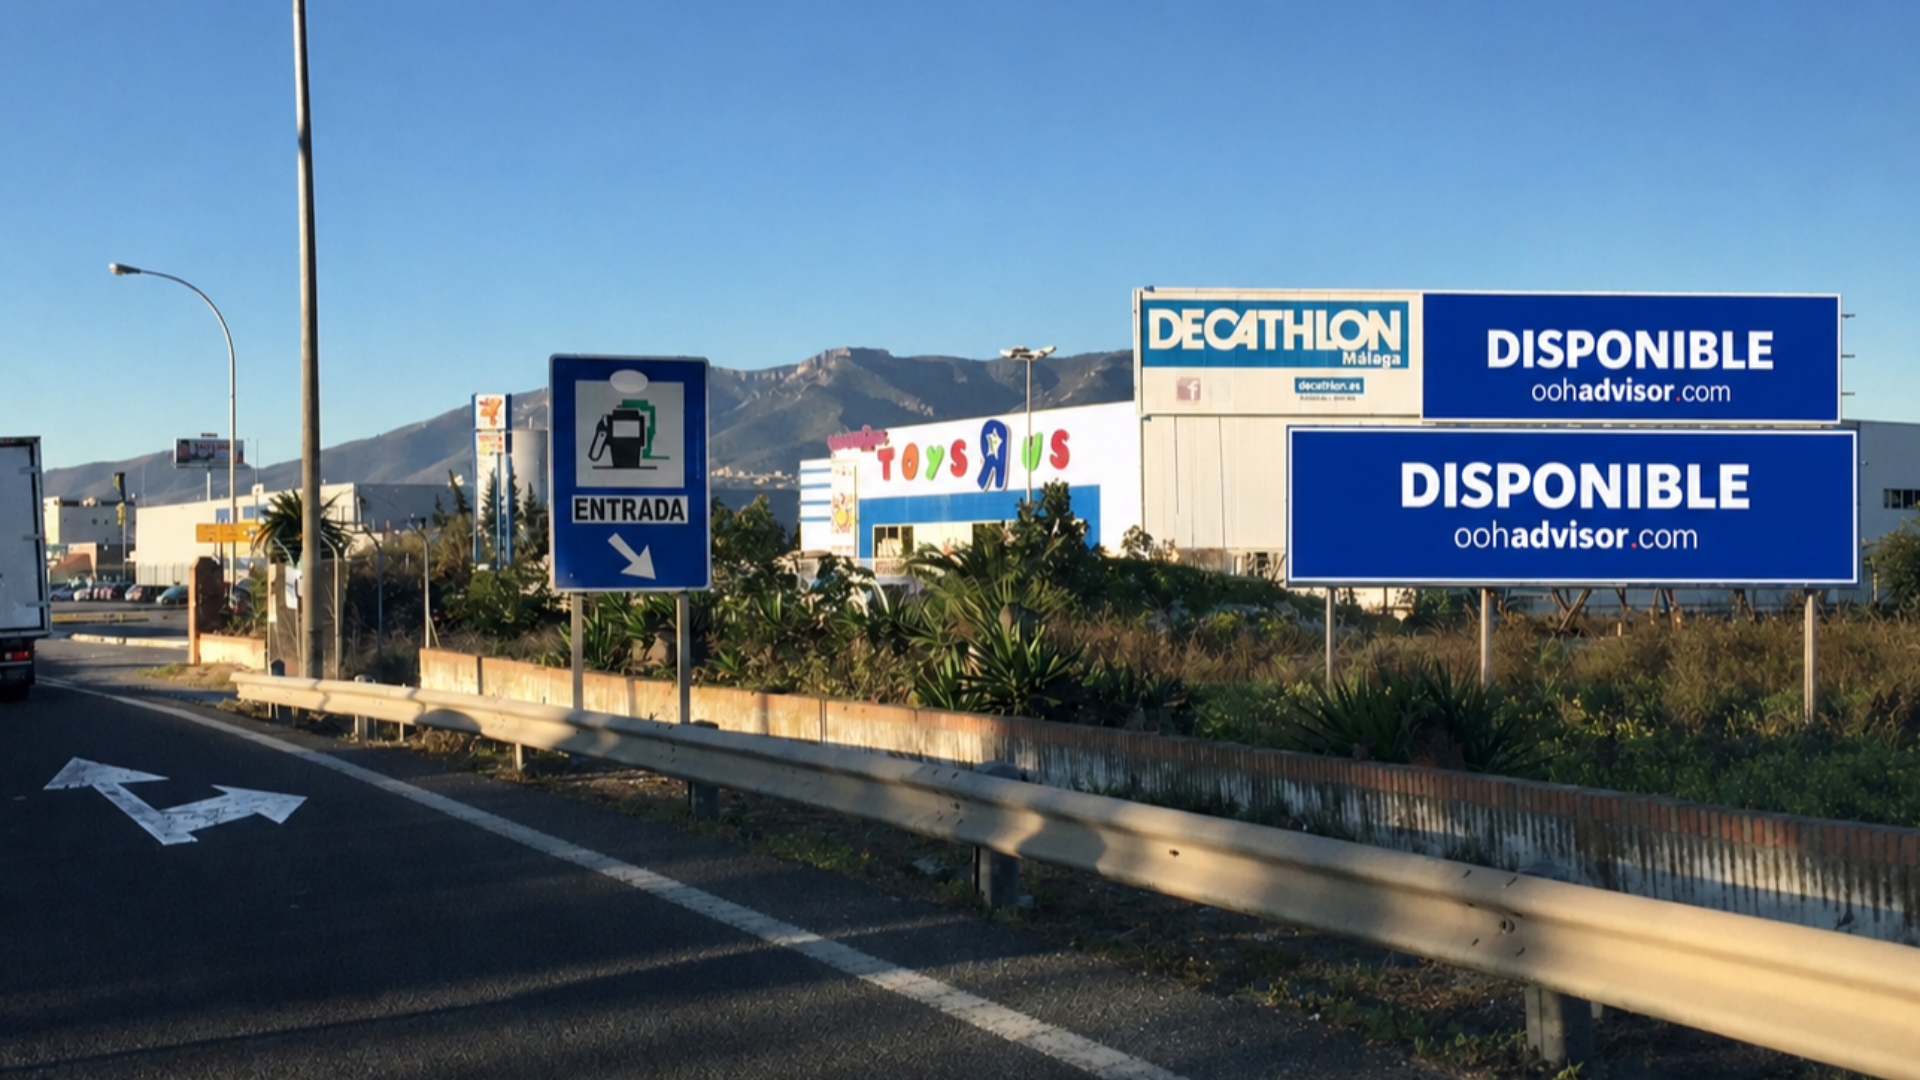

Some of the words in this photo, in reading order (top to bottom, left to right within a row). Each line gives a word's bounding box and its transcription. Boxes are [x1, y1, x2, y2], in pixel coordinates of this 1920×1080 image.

[1148, 308, 1401, 351] DECATHLON
[1342, 350, 1401, 369] Málaga
[1487, 329, 1774, 370] DISPONIBLE
[1531, 377, 1731, 402] oohadvisor.com
[877, 438, 969, 482] TOYS
[1021, 429, 1070, 471] US
[1401, 461, 1750, 510] DISPONIBLE
[574, 497, 686, 522] ENTRADA
[1454, 520, 1699, 550] oohadvisor.com
